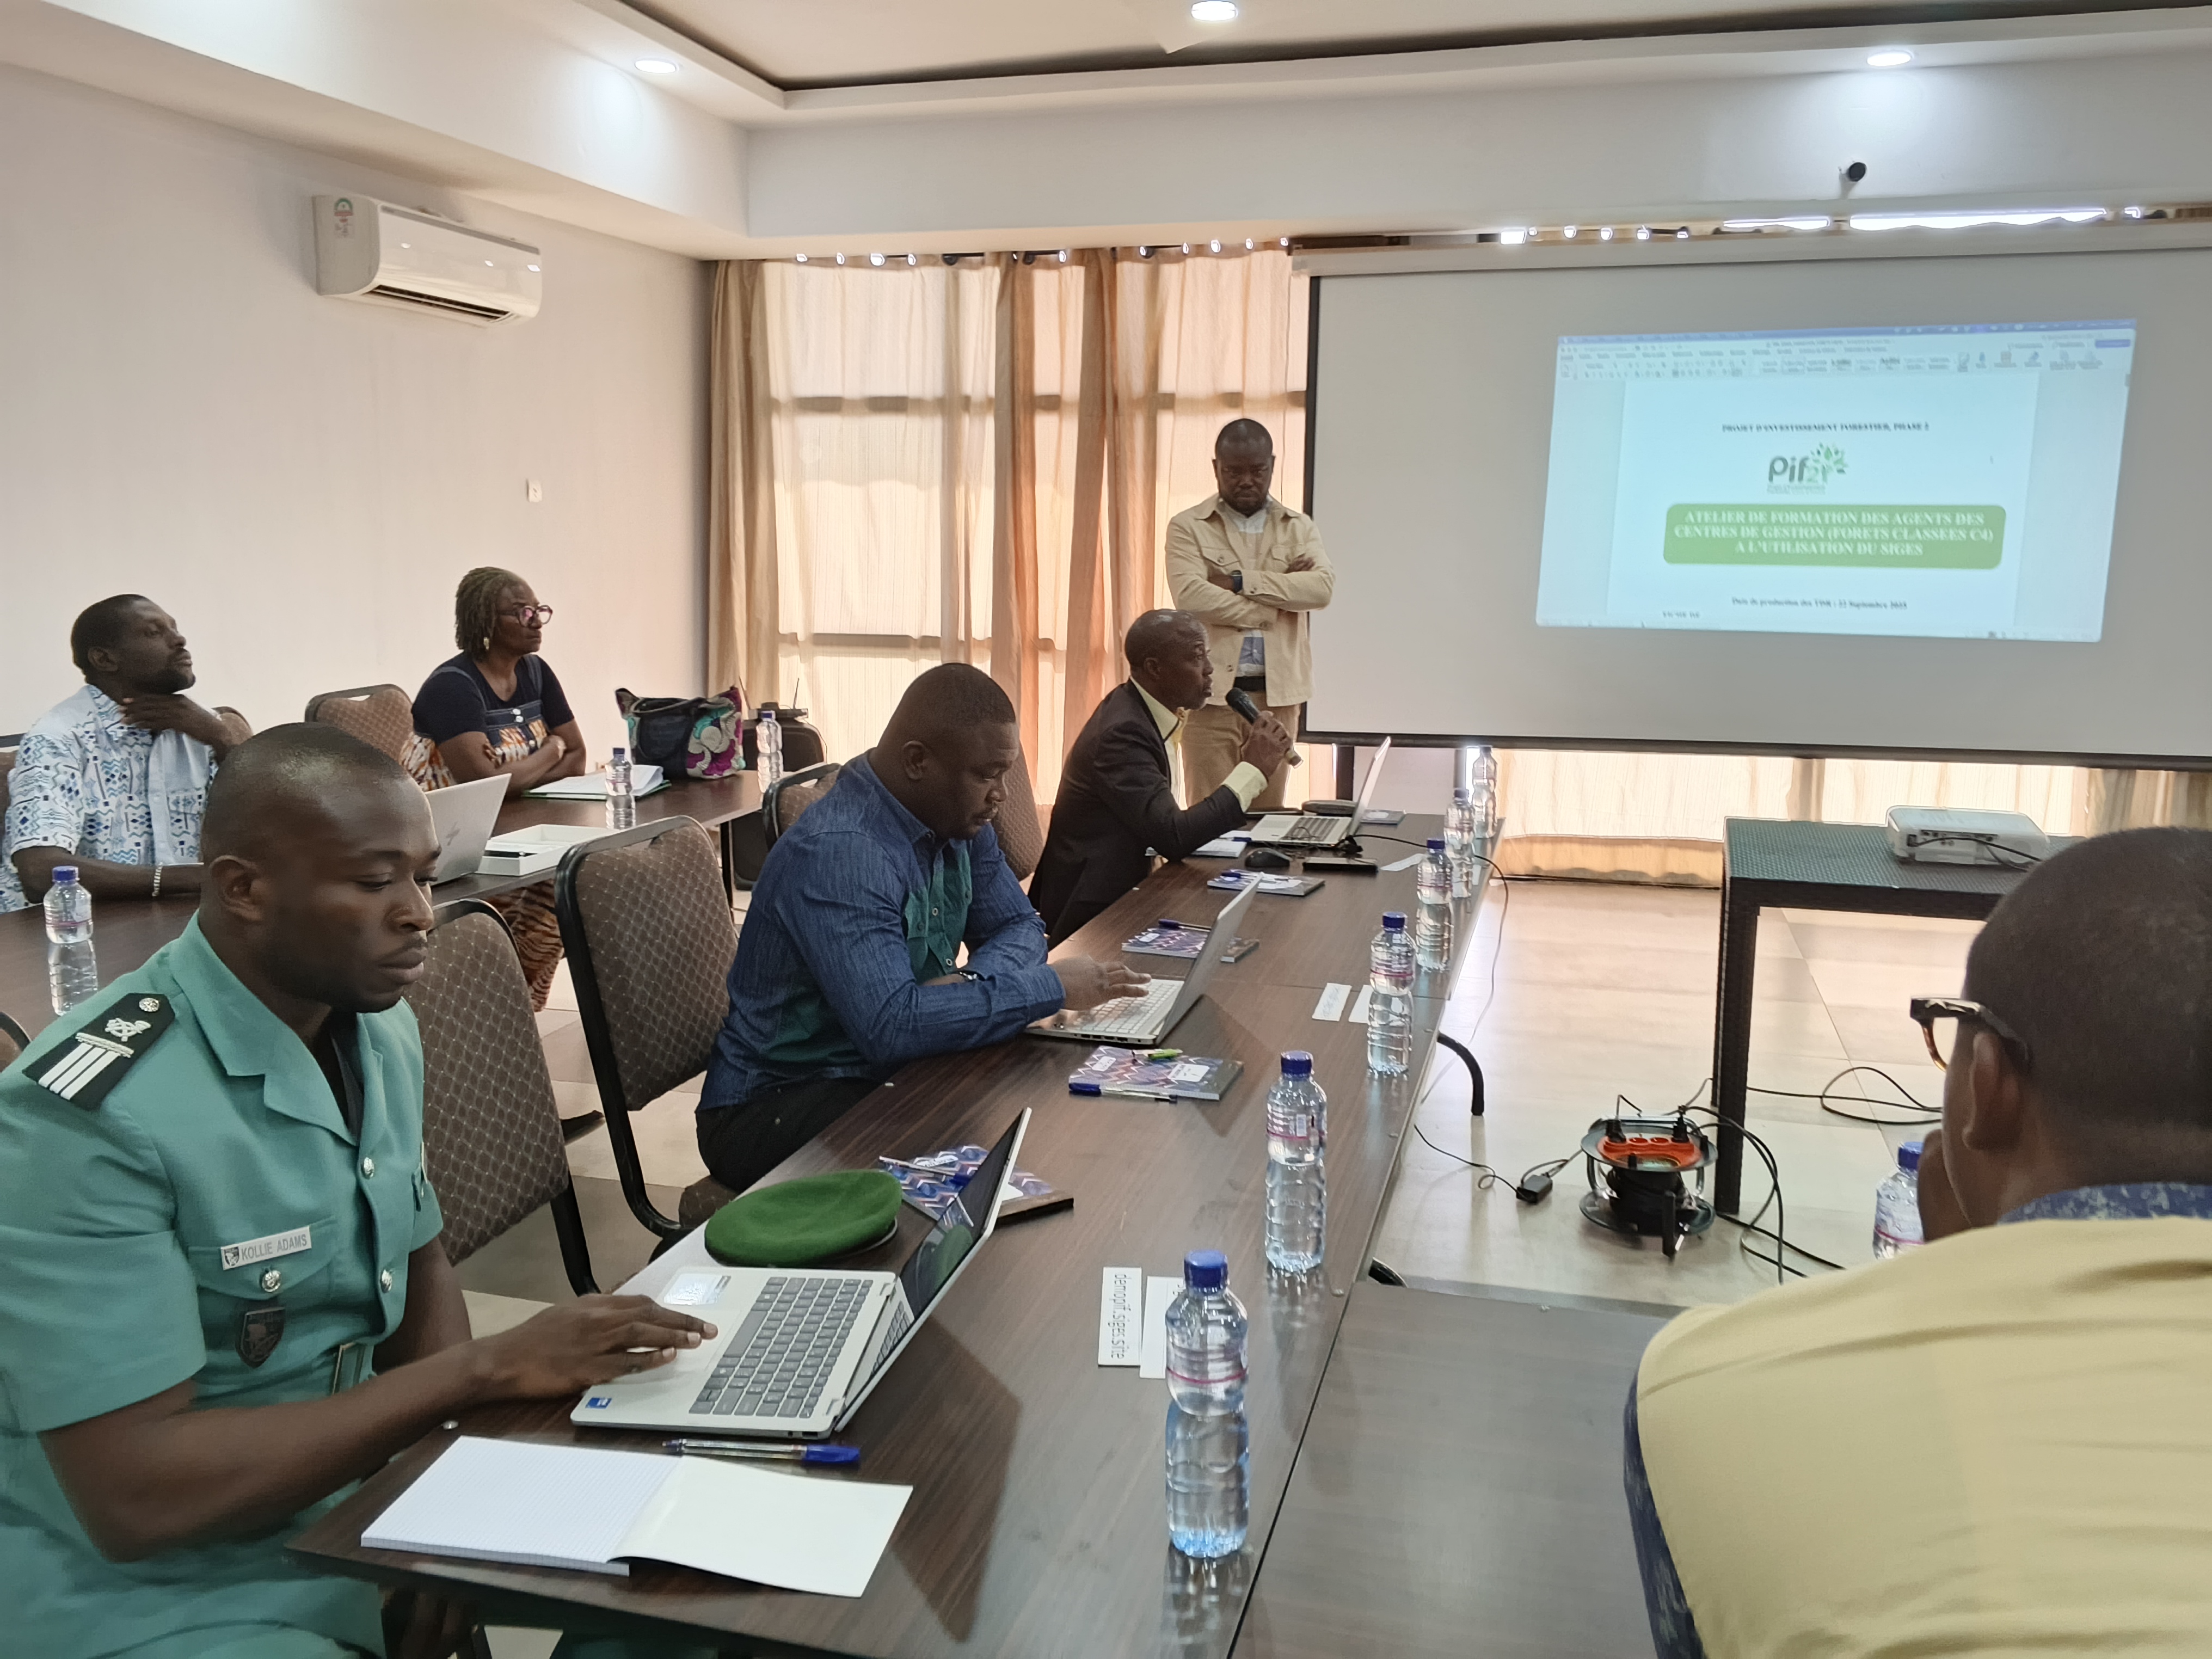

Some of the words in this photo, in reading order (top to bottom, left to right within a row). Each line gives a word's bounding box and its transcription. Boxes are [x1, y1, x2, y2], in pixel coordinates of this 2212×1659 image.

[1687, 511, 1745, 523] ATELIER
[1748, 511, 1767, 523] DE
[1771, 511, 1858, 524] FORMATION
[1861, 512, 1889, 524] DES
[1893, 512, 1951, 525] AGENTS
[1956, 512, 1984, 525] DES
[1674, 524, 1737, 538] CENTRES
[1741, 525, 1759, 538] DE
[1762, 525, 1824, 538] GESTION
[1749, 540, 1853, 554] L'UTILISATION
[1857, 542, 1877, 555] DU
[1880, 542, 1924, 555] SIGES
[241, 1242, 273, 1261] KOLLIE
[276, 1234, 308, 1252] ADAMS
